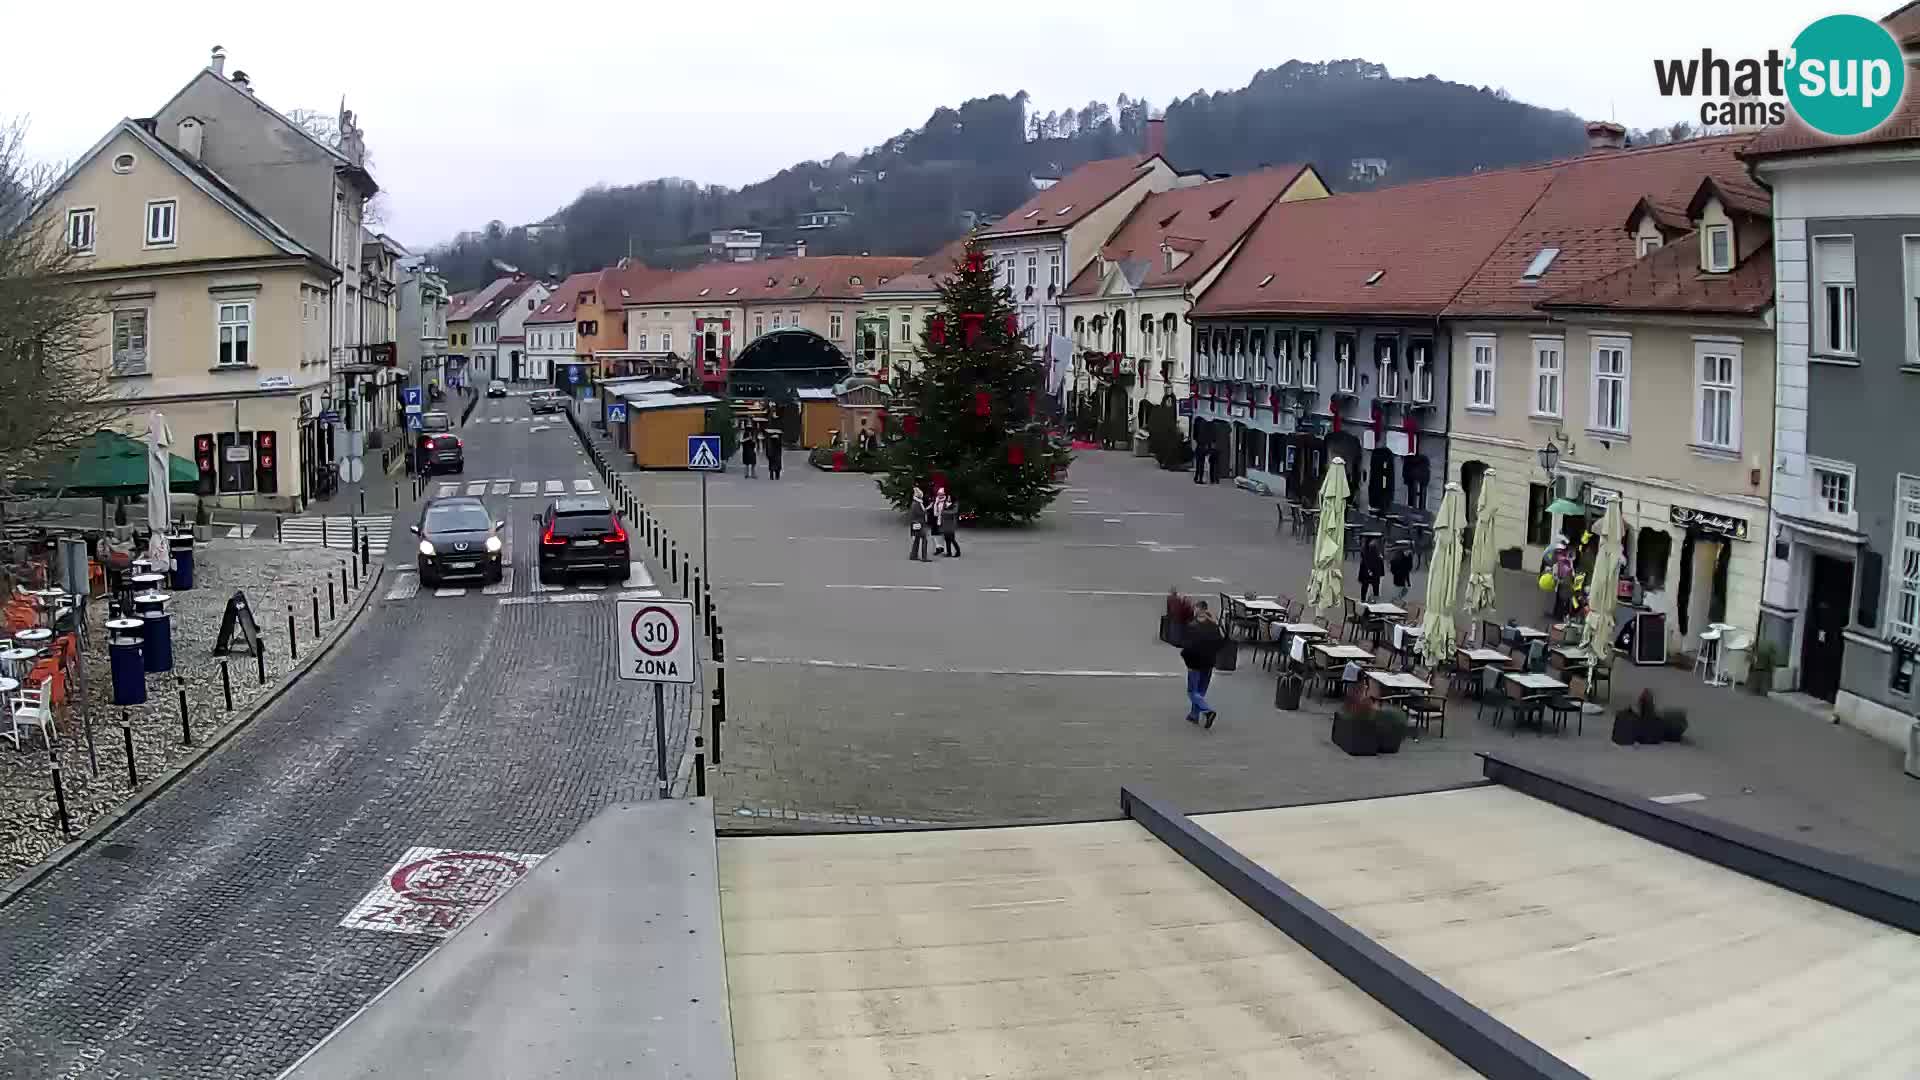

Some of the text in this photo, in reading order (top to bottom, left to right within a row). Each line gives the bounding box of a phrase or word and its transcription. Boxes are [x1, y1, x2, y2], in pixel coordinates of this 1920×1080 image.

[409, 391, 417, 403] P
[644, 622, 668, 643] 30
[634, 659, 678, 676] ZONA
